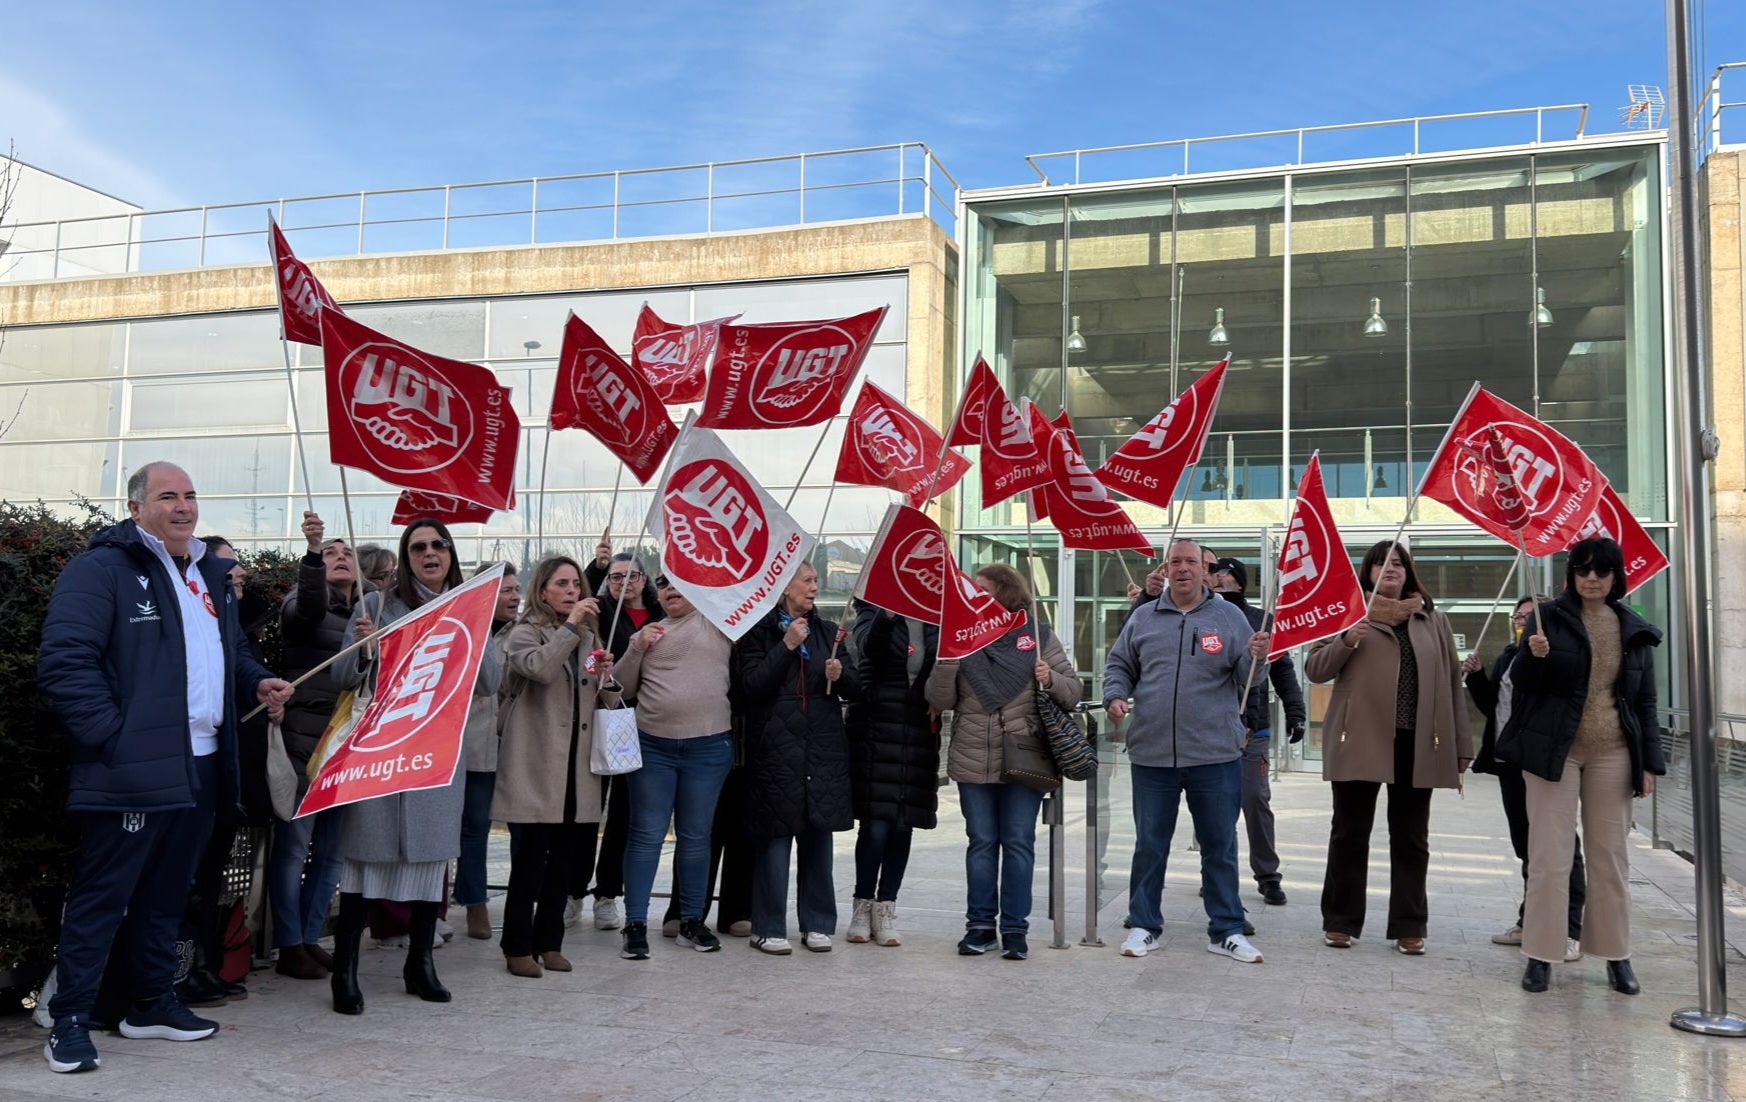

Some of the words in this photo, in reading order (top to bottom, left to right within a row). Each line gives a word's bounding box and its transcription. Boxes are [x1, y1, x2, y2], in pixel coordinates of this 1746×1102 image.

[283, 262, 319, 317] UG
[353, 353, 456, 425] UGT
[715, 328, 750, 420] www.ugt.es
[768, 344, 849, 388] UGT
[478, 388, 506, 484] www.ugt.es
[1131, 397, 1181, 450] GT
[682, 464, 764, 552] UGT
[1536, 476, 1593, 545] www.ugt.es
[724, 532, 801, 627] www.UGT.es
[380, 631, 456, 728] UGT
[320, 752, 433, 790] www.ugt.es
